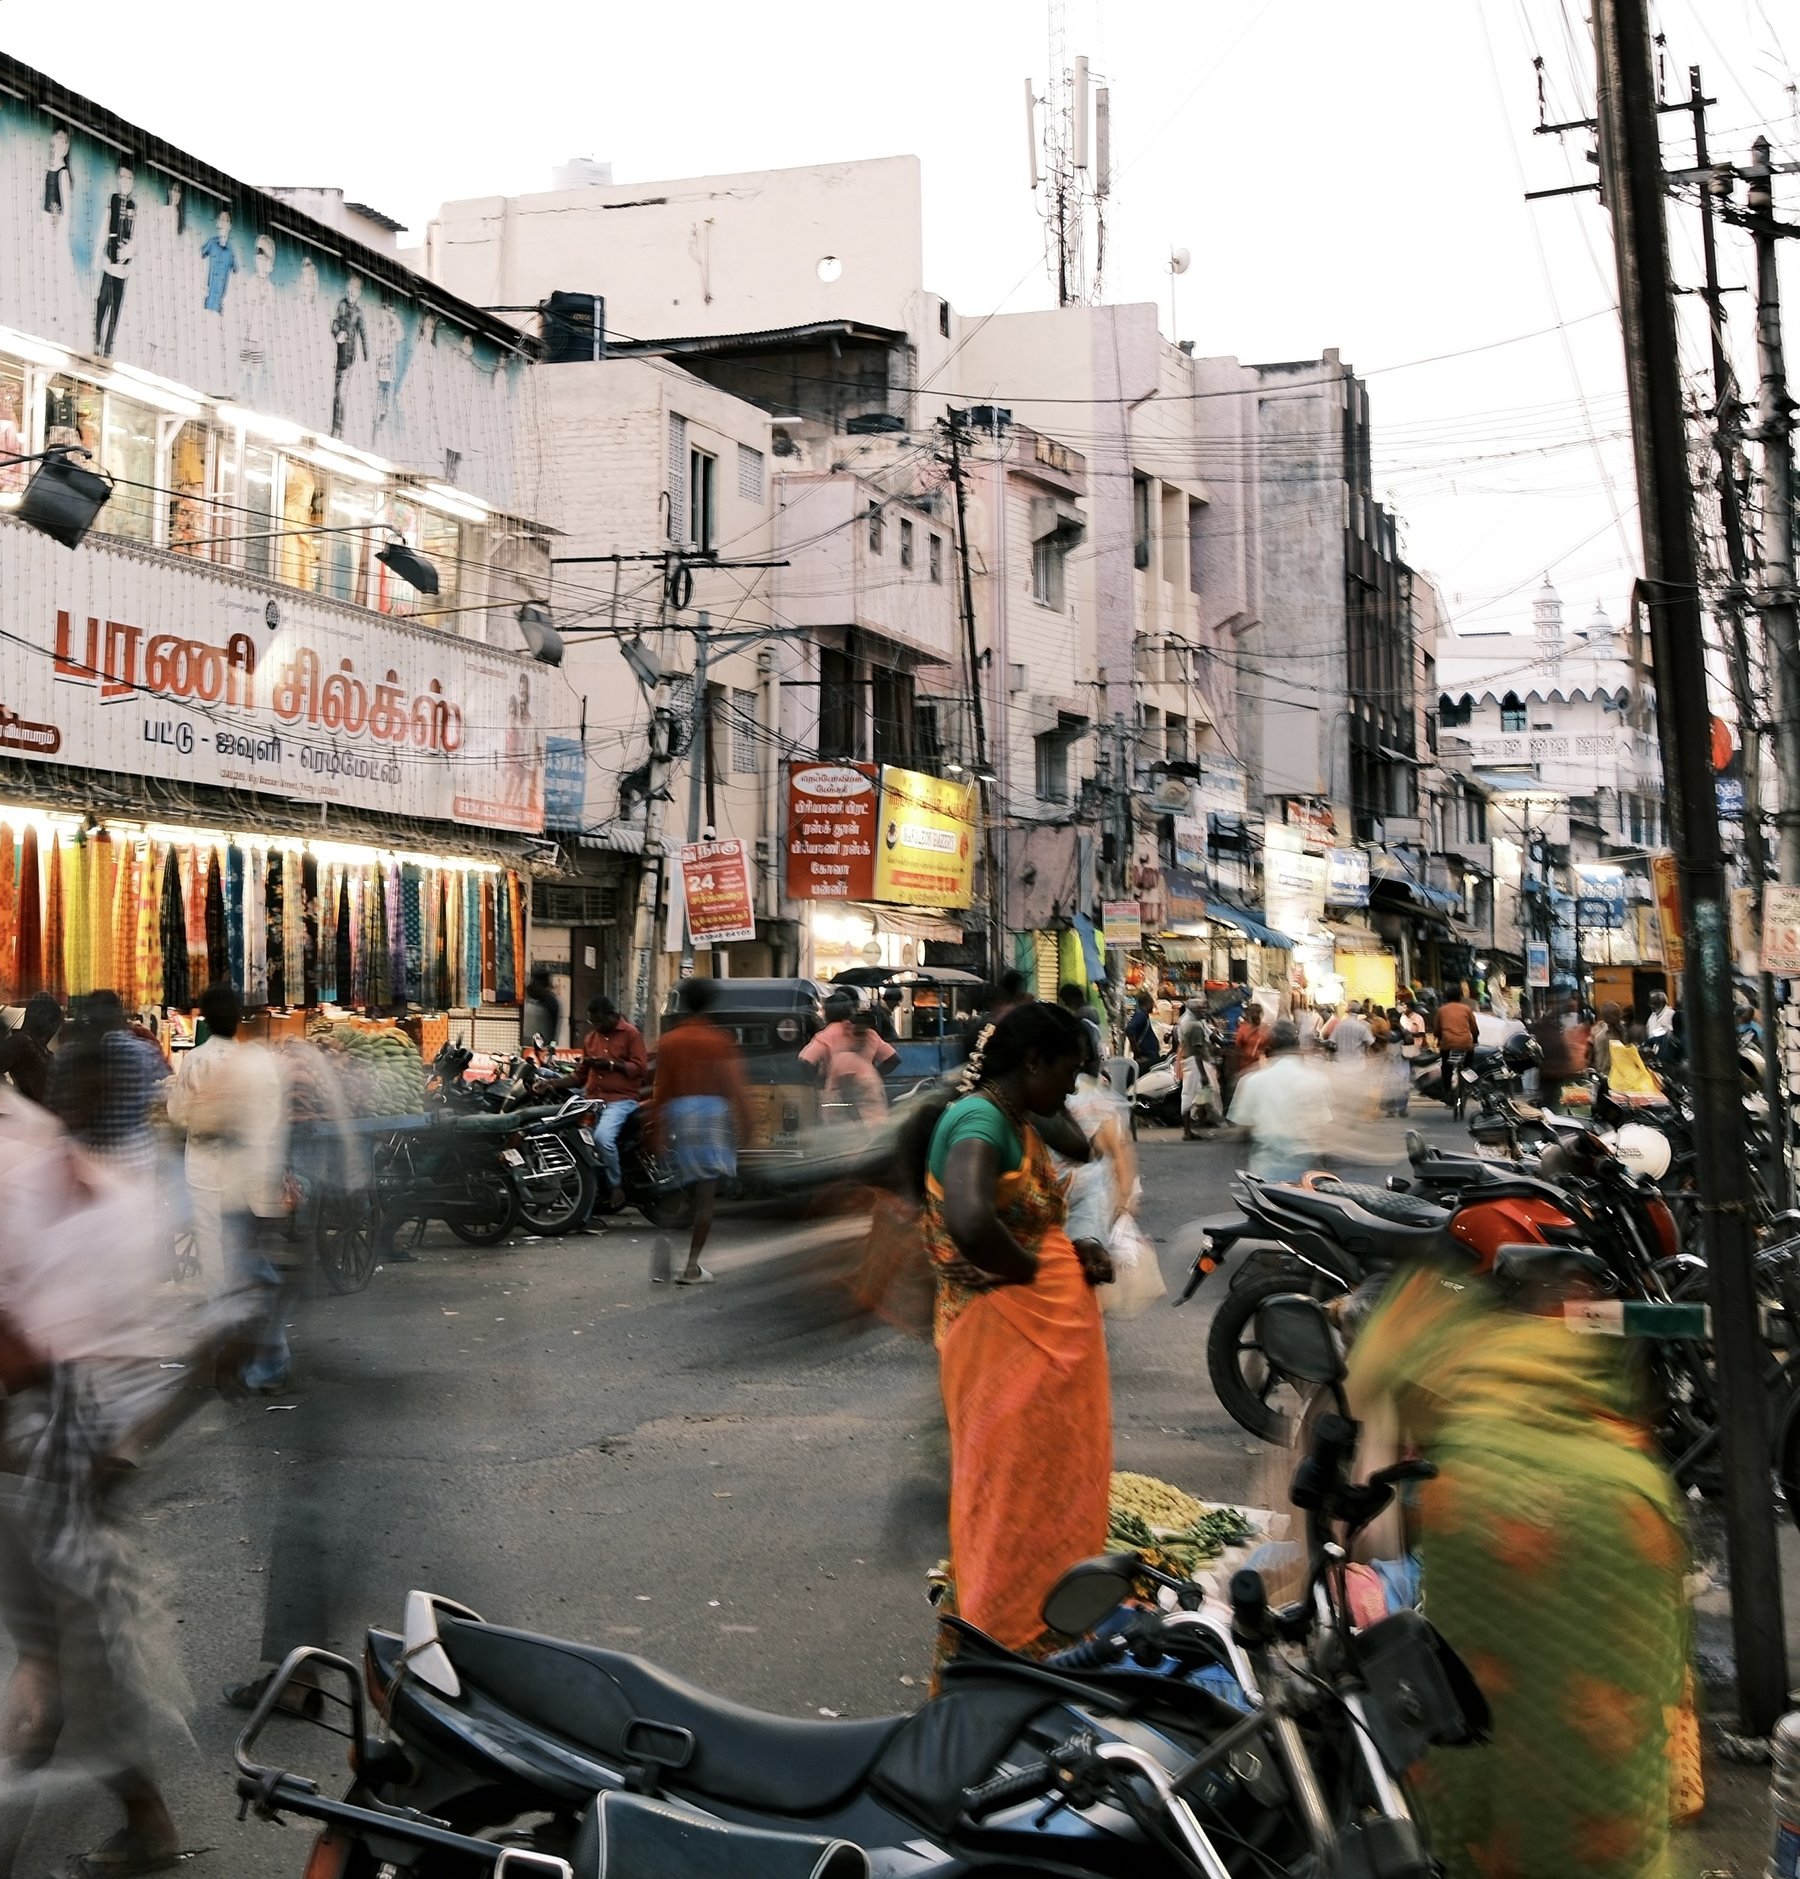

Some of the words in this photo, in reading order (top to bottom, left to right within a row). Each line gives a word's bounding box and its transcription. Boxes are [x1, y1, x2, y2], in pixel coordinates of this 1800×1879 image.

[54, 608, 256, 714] பரணி
[272, 645, 465, 754] சில்க்ஸ்
[143, 718, 195, 755] பட்டு
[687, 872, 716, 893] 24
